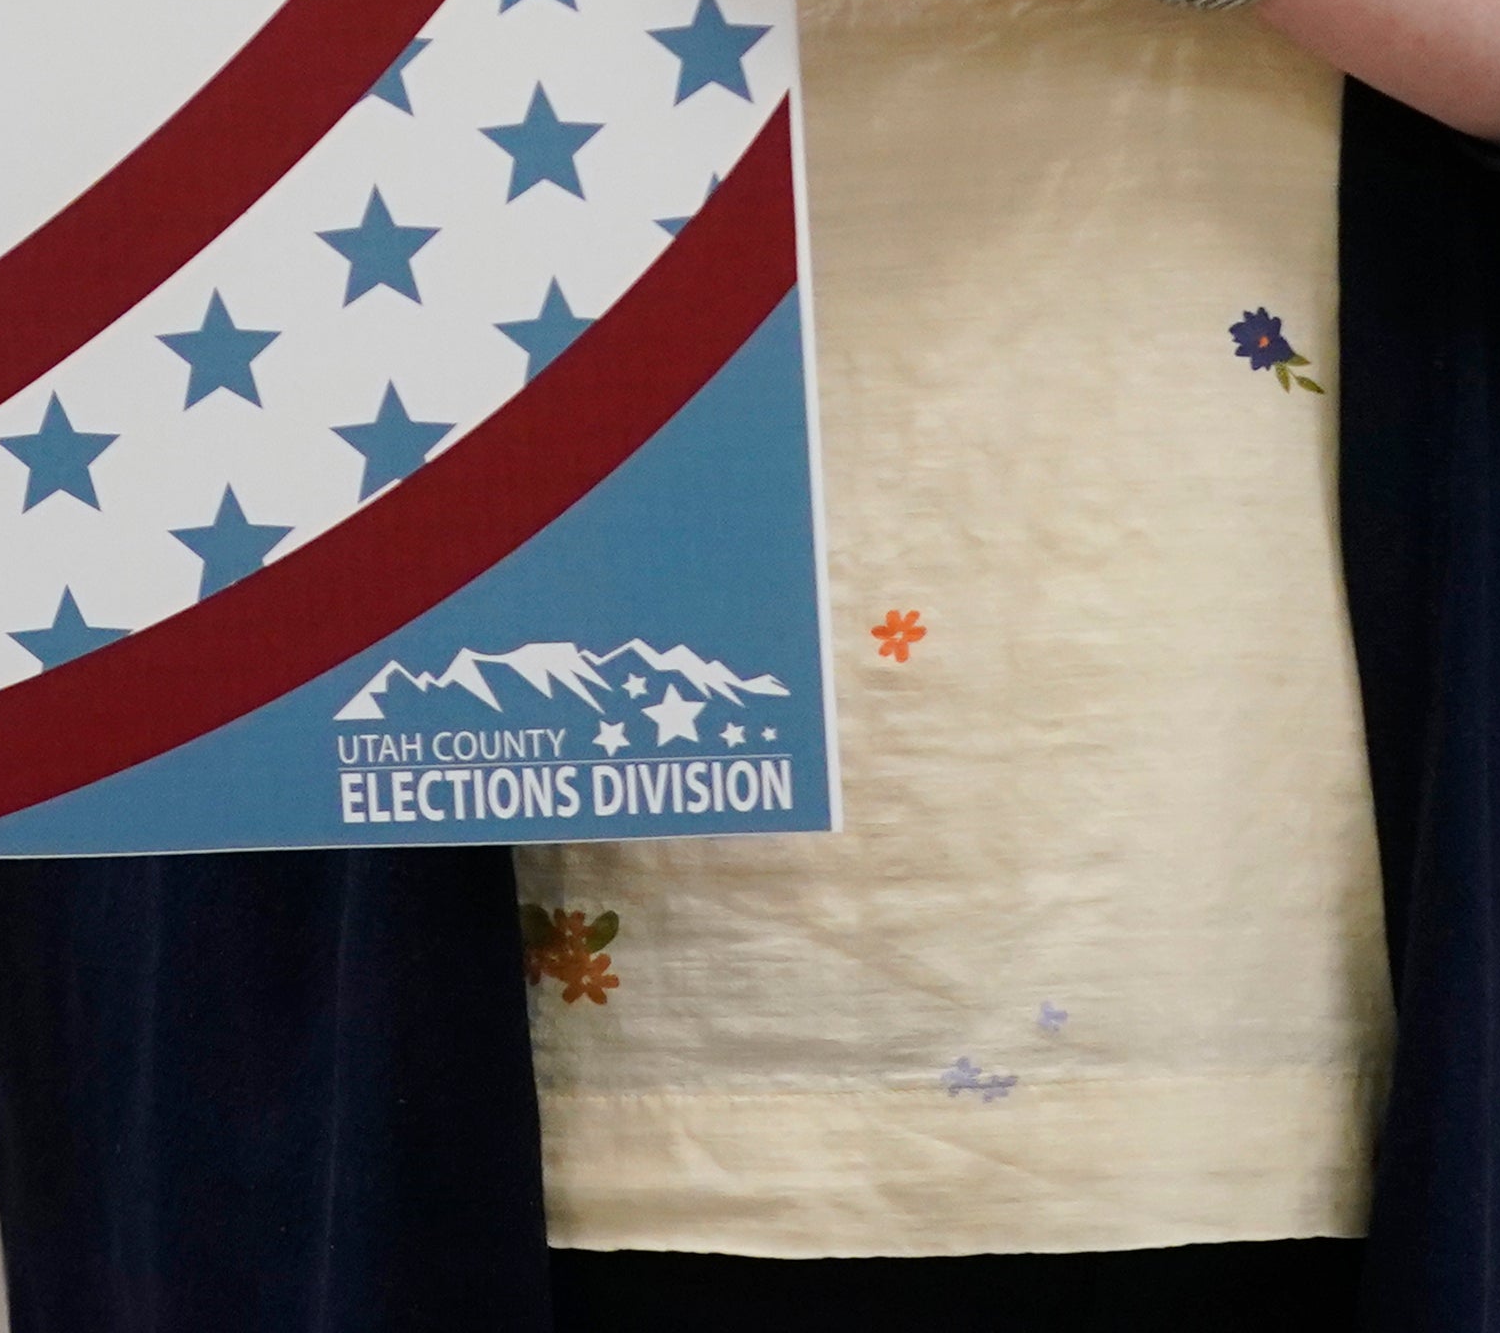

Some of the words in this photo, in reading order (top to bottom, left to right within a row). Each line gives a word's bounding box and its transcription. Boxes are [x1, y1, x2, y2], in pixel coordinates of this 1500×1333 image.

[337, 733, 423, 765] UTAH
[432, 728, 567, 762] COUNTY
[339, 765, 581, 824] ELECTIONS
[592, 759, 794, 817] DIVISION
